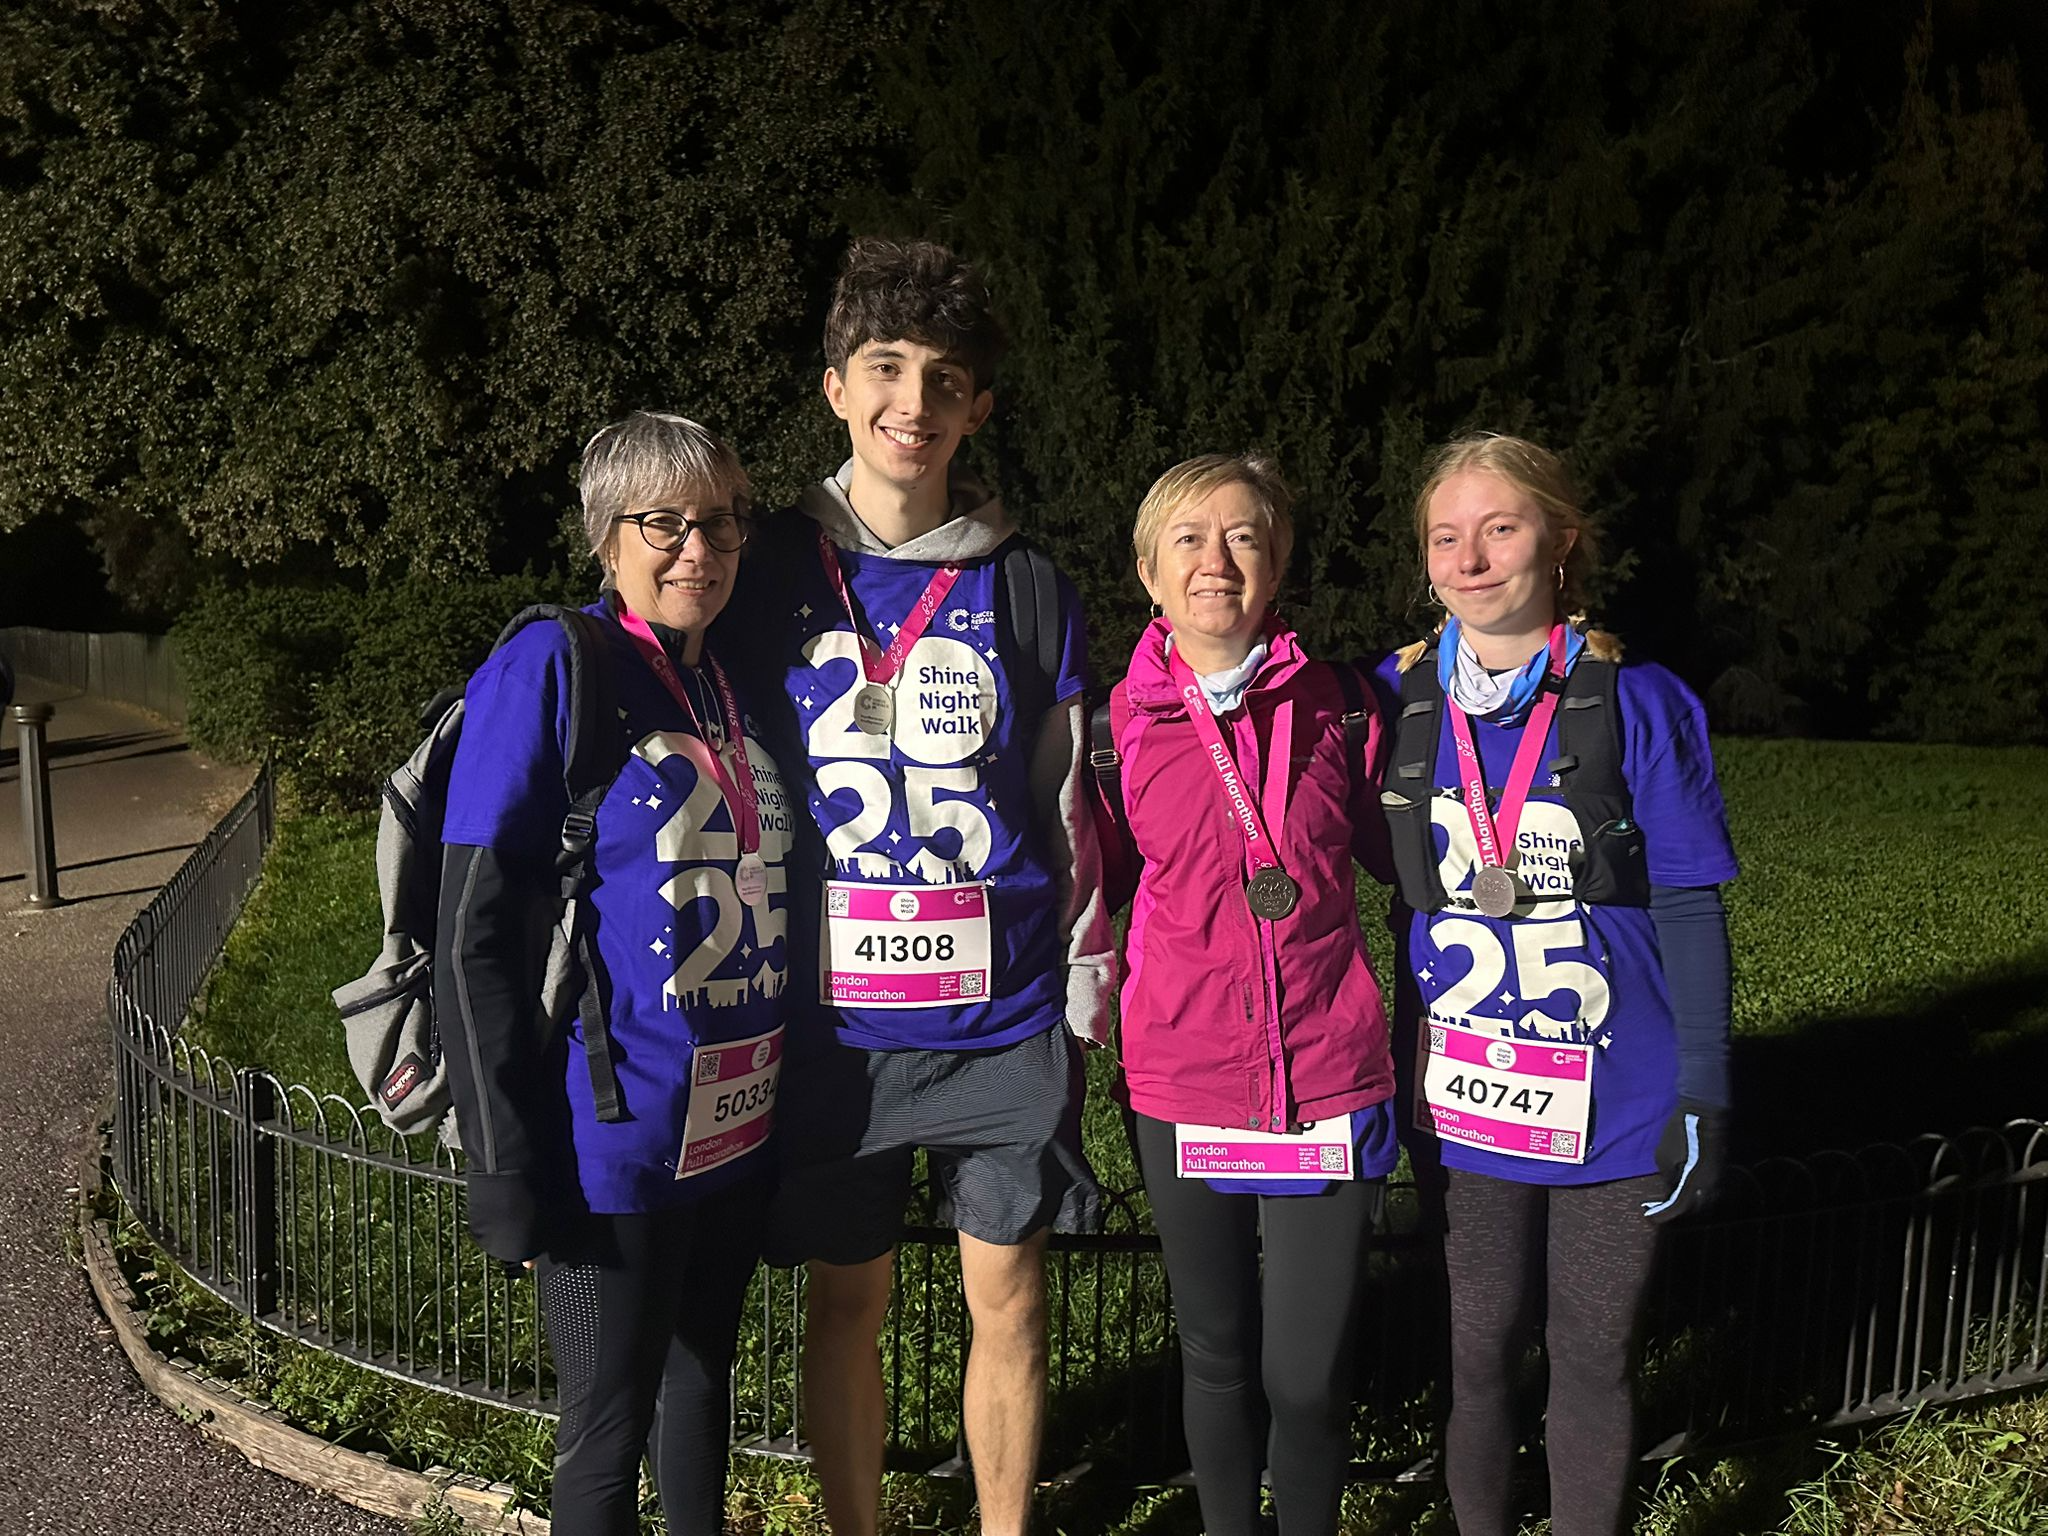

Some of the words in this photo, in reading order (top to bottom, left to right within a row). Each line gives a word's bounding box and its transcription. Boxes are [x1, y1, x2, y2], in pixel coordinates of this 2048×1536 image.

[970, 611, 995, 619] CANCER
[970, 617, 997, 625] RESEARC
[919, 665, 979, 686] Shine
[919, 691, 980, 713] Night
[921, 716, 979, 735] Walk
[1209, 742, 1232, 773] Full
[1222, 770, 1259, 841] Marathon
[815, 760, 992, 884] 25
[1470, 779, 1494, 851] Marathon
[1519, 832, 1581, 852] Shine
[1483, 850, 1498, 867] ll
[1522, 852, 1571, 872] Nigh
[1522, 872, 1574, 890] Wal
[854, 934, 955, 962] 41308
[1429, 916, 1610, 1042] 25
[849, 988, 906, 1000] marathon
[1446, 1074, 1554, 1116] 40747
[1428, 1107, 1460, 1122] ondon
[1440, 1122, 1495, 1144] marathon
[686, 1151, 706, 1168] full
[706, 1141, 745, 1162] marathon
[689, 1138, 723, 1156] London
[1185, 1145, 1228, 1156] London
[1185, 1158, 1208, 1170] full
[1208, 1158, 1266, 1171] marathon
